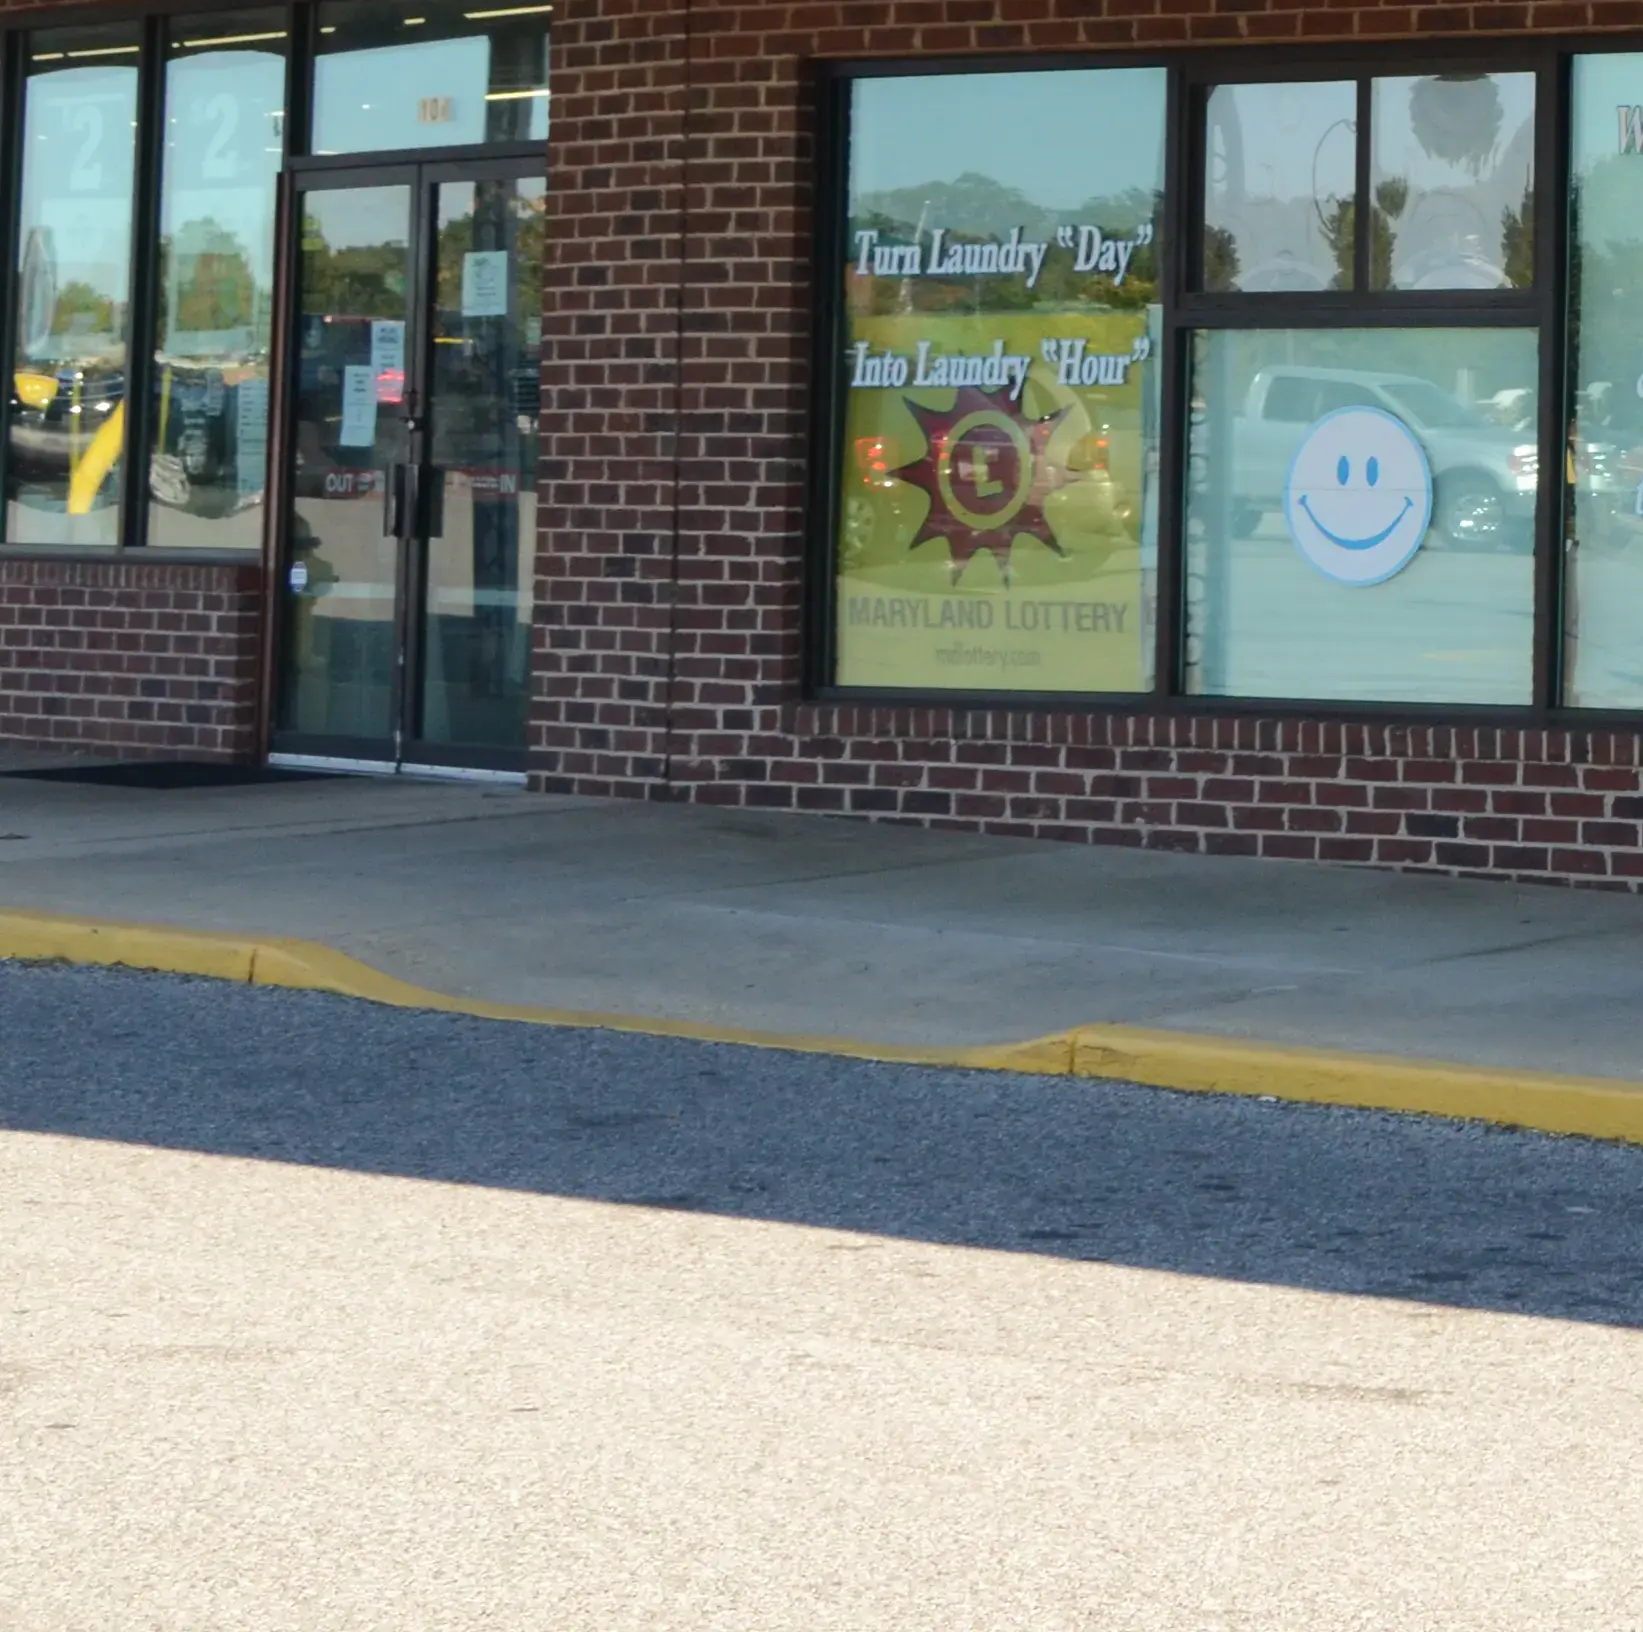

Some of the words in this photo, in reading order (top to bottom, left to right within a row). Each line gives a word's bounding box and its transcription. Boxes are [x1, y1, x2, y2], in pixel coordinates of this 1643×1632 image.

[855, 229, 920, 276] Turn
[927, 227, 1047, 288] Laundry
[851, 341, 908, 387] Into
[913, 339, 1031, 401] Laundry
[326, 473, 353, 493] OUT
[500, 474, 516, 493] IN
[849, 596, 994, 630] MARYLAND
[1004, 600, 1128, 634] LOTTERY
